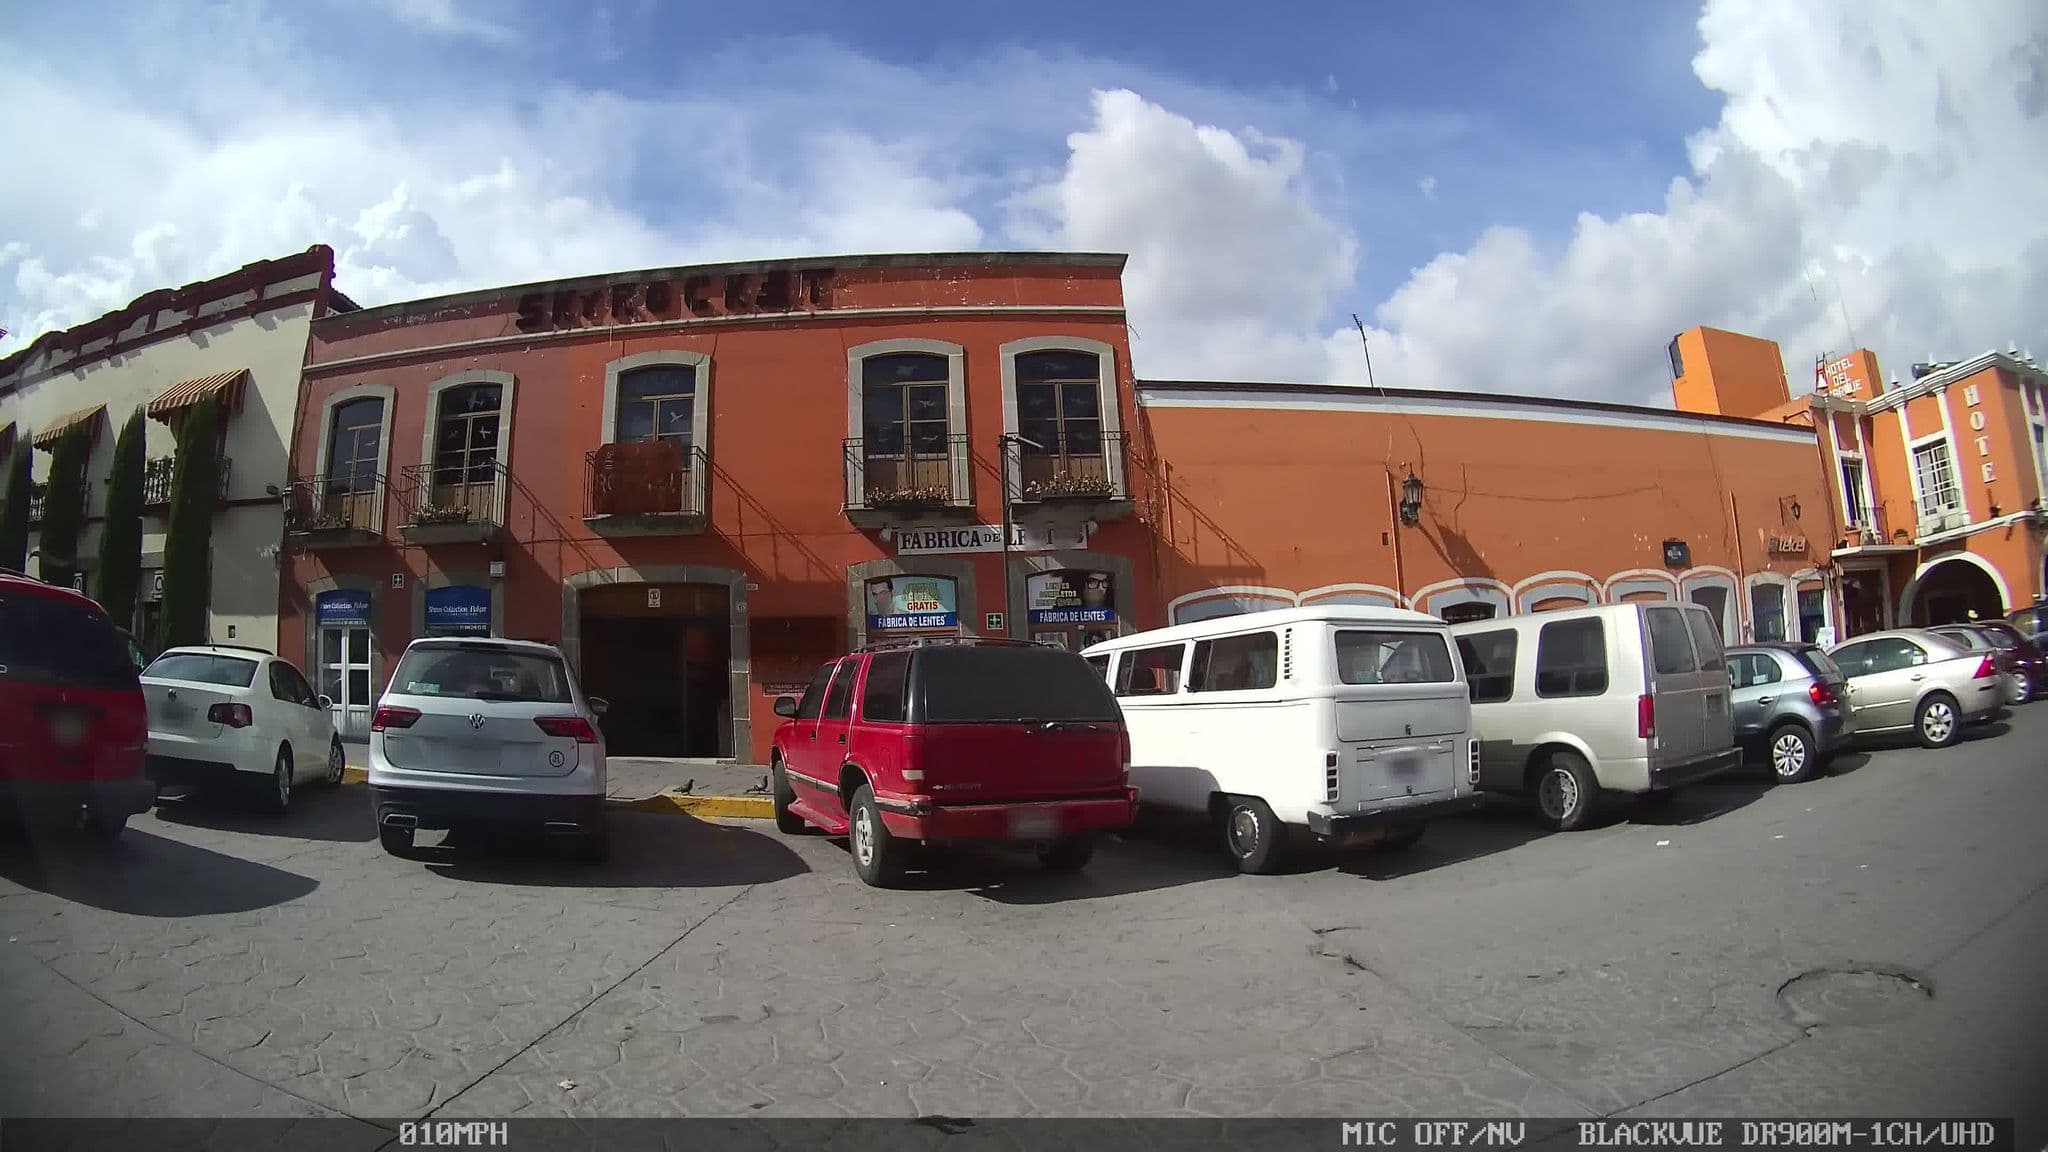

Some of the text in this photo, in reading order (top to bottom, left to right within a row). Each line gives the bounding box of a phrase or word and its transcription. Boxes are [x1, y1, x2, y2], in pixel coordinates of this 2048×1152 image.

[1825, 357, 1854, 376] HOTEL
[1832, 371, 1850, 387] DEL
[900, 530, 982, 549] FABRICA
[984, 533, 1001, 543] DE
[907, 601, 938, 611] GRATIS
[908, 616, 919, 627] DE
[1069, 611, 1079, 621] DE
